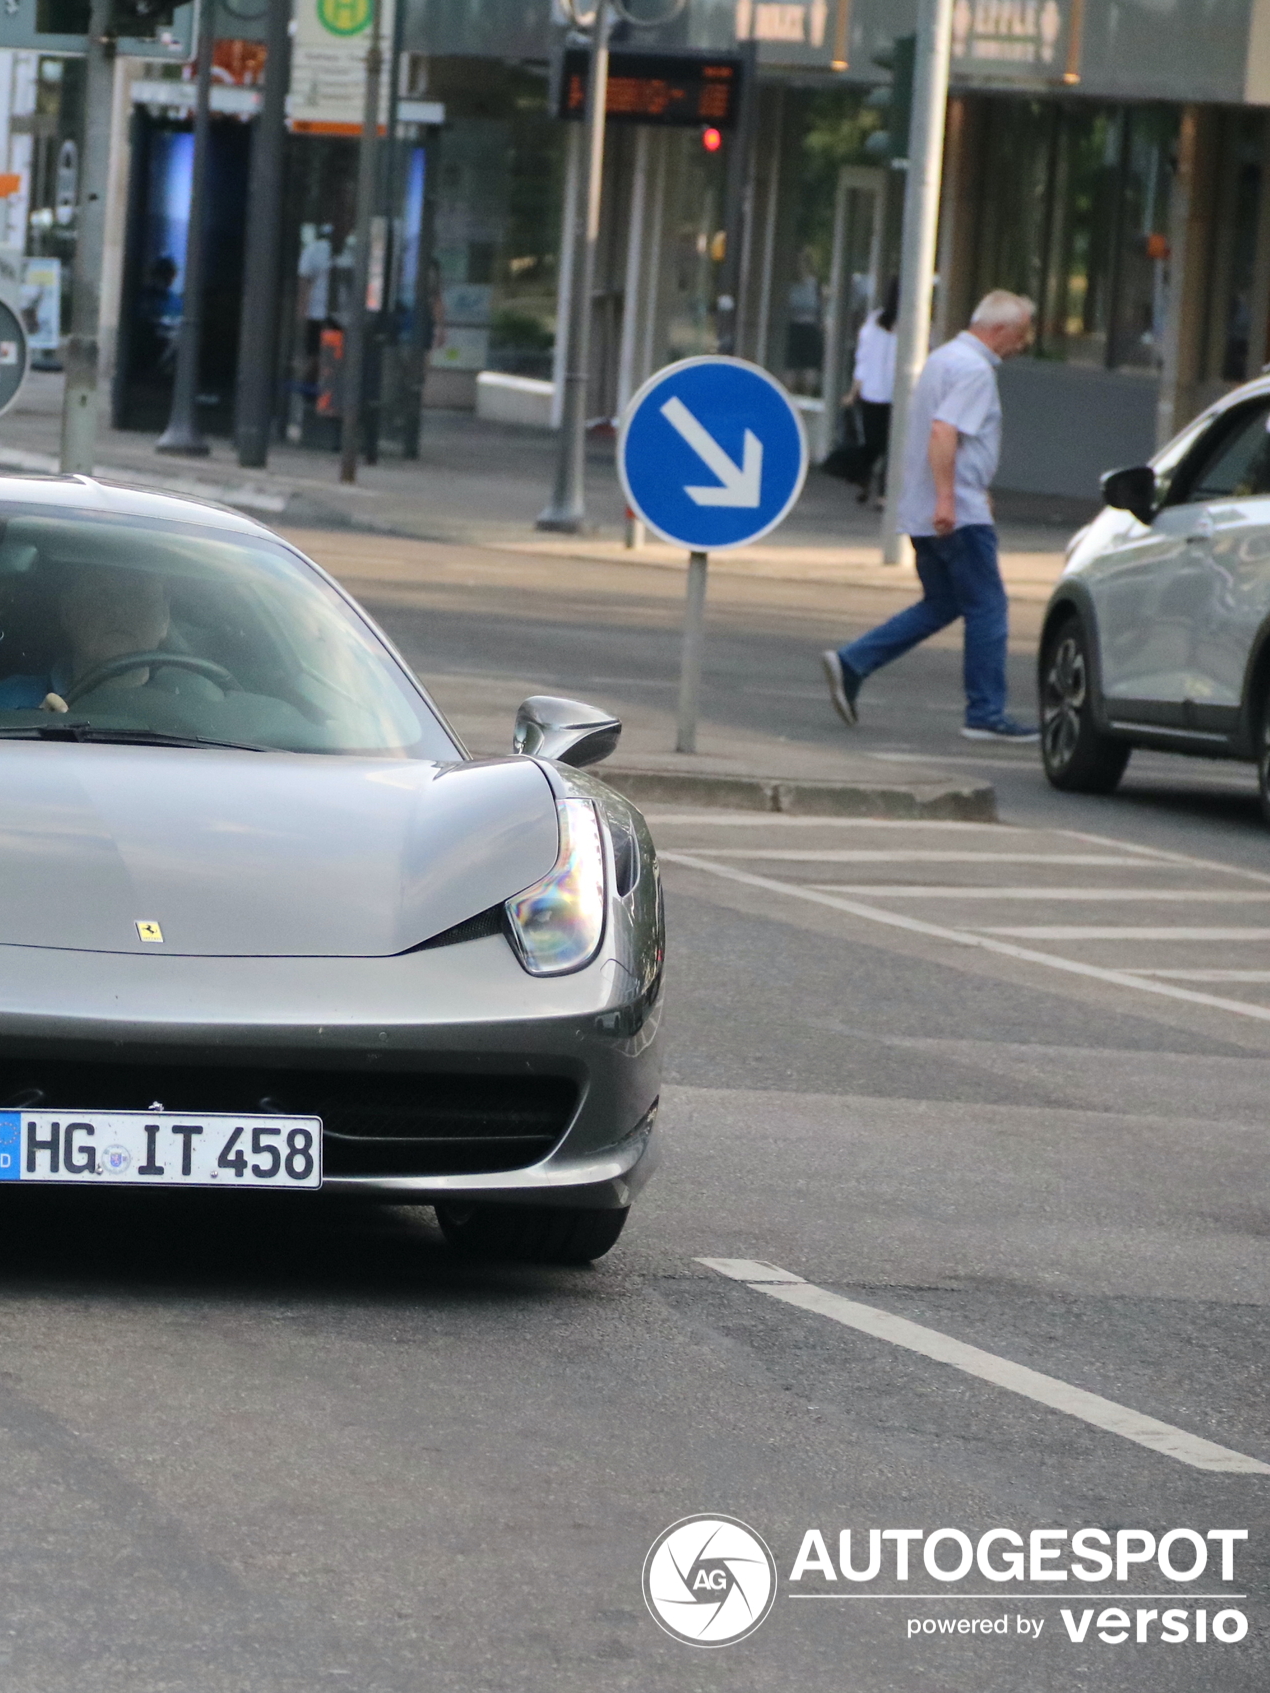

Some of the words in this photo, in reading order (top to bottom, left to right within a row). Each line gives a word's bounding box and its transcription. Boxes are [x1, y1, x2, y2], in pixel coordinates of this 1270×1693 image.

[0, 1153, 11, 1168] D
[26, 1121, 97, 1174] HG
[138, 1124, 204, 1176] IT
[217, 1126, 314, 1180] 458
